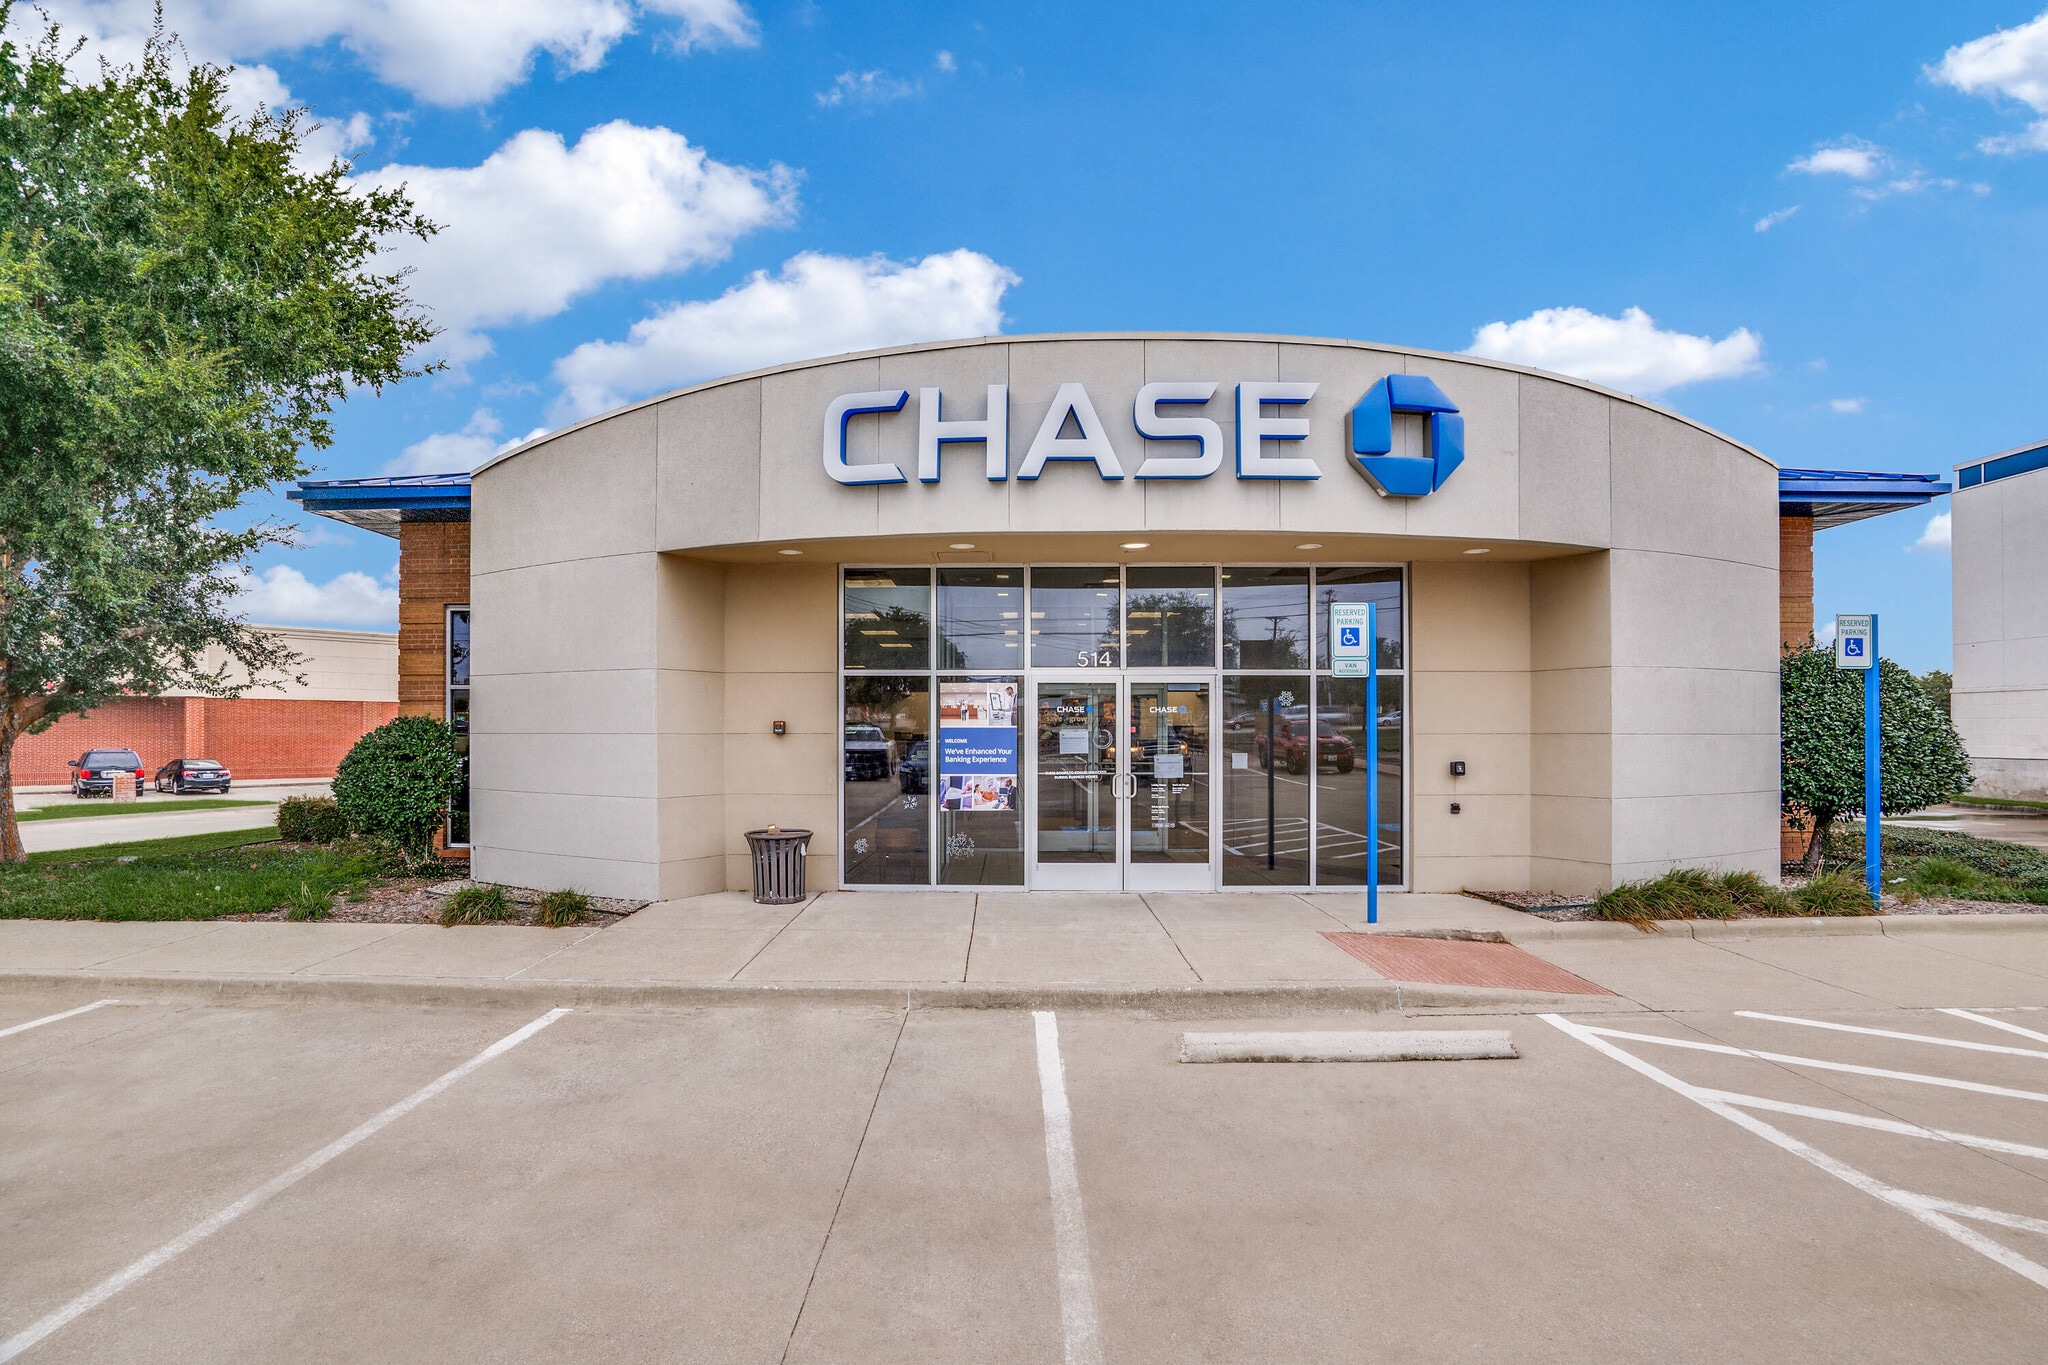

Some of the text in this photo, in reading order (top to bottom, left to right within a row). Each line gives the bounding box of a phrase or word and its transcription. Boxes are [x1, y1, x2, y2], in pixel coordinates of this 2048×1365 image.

[822, 381, 1321, 486] CHASE
[1334, 608, 1366, 616] RESERVED
[1077, 651, 1112, 667] 514
[945, 756, 1007, 764] Banking Experience
